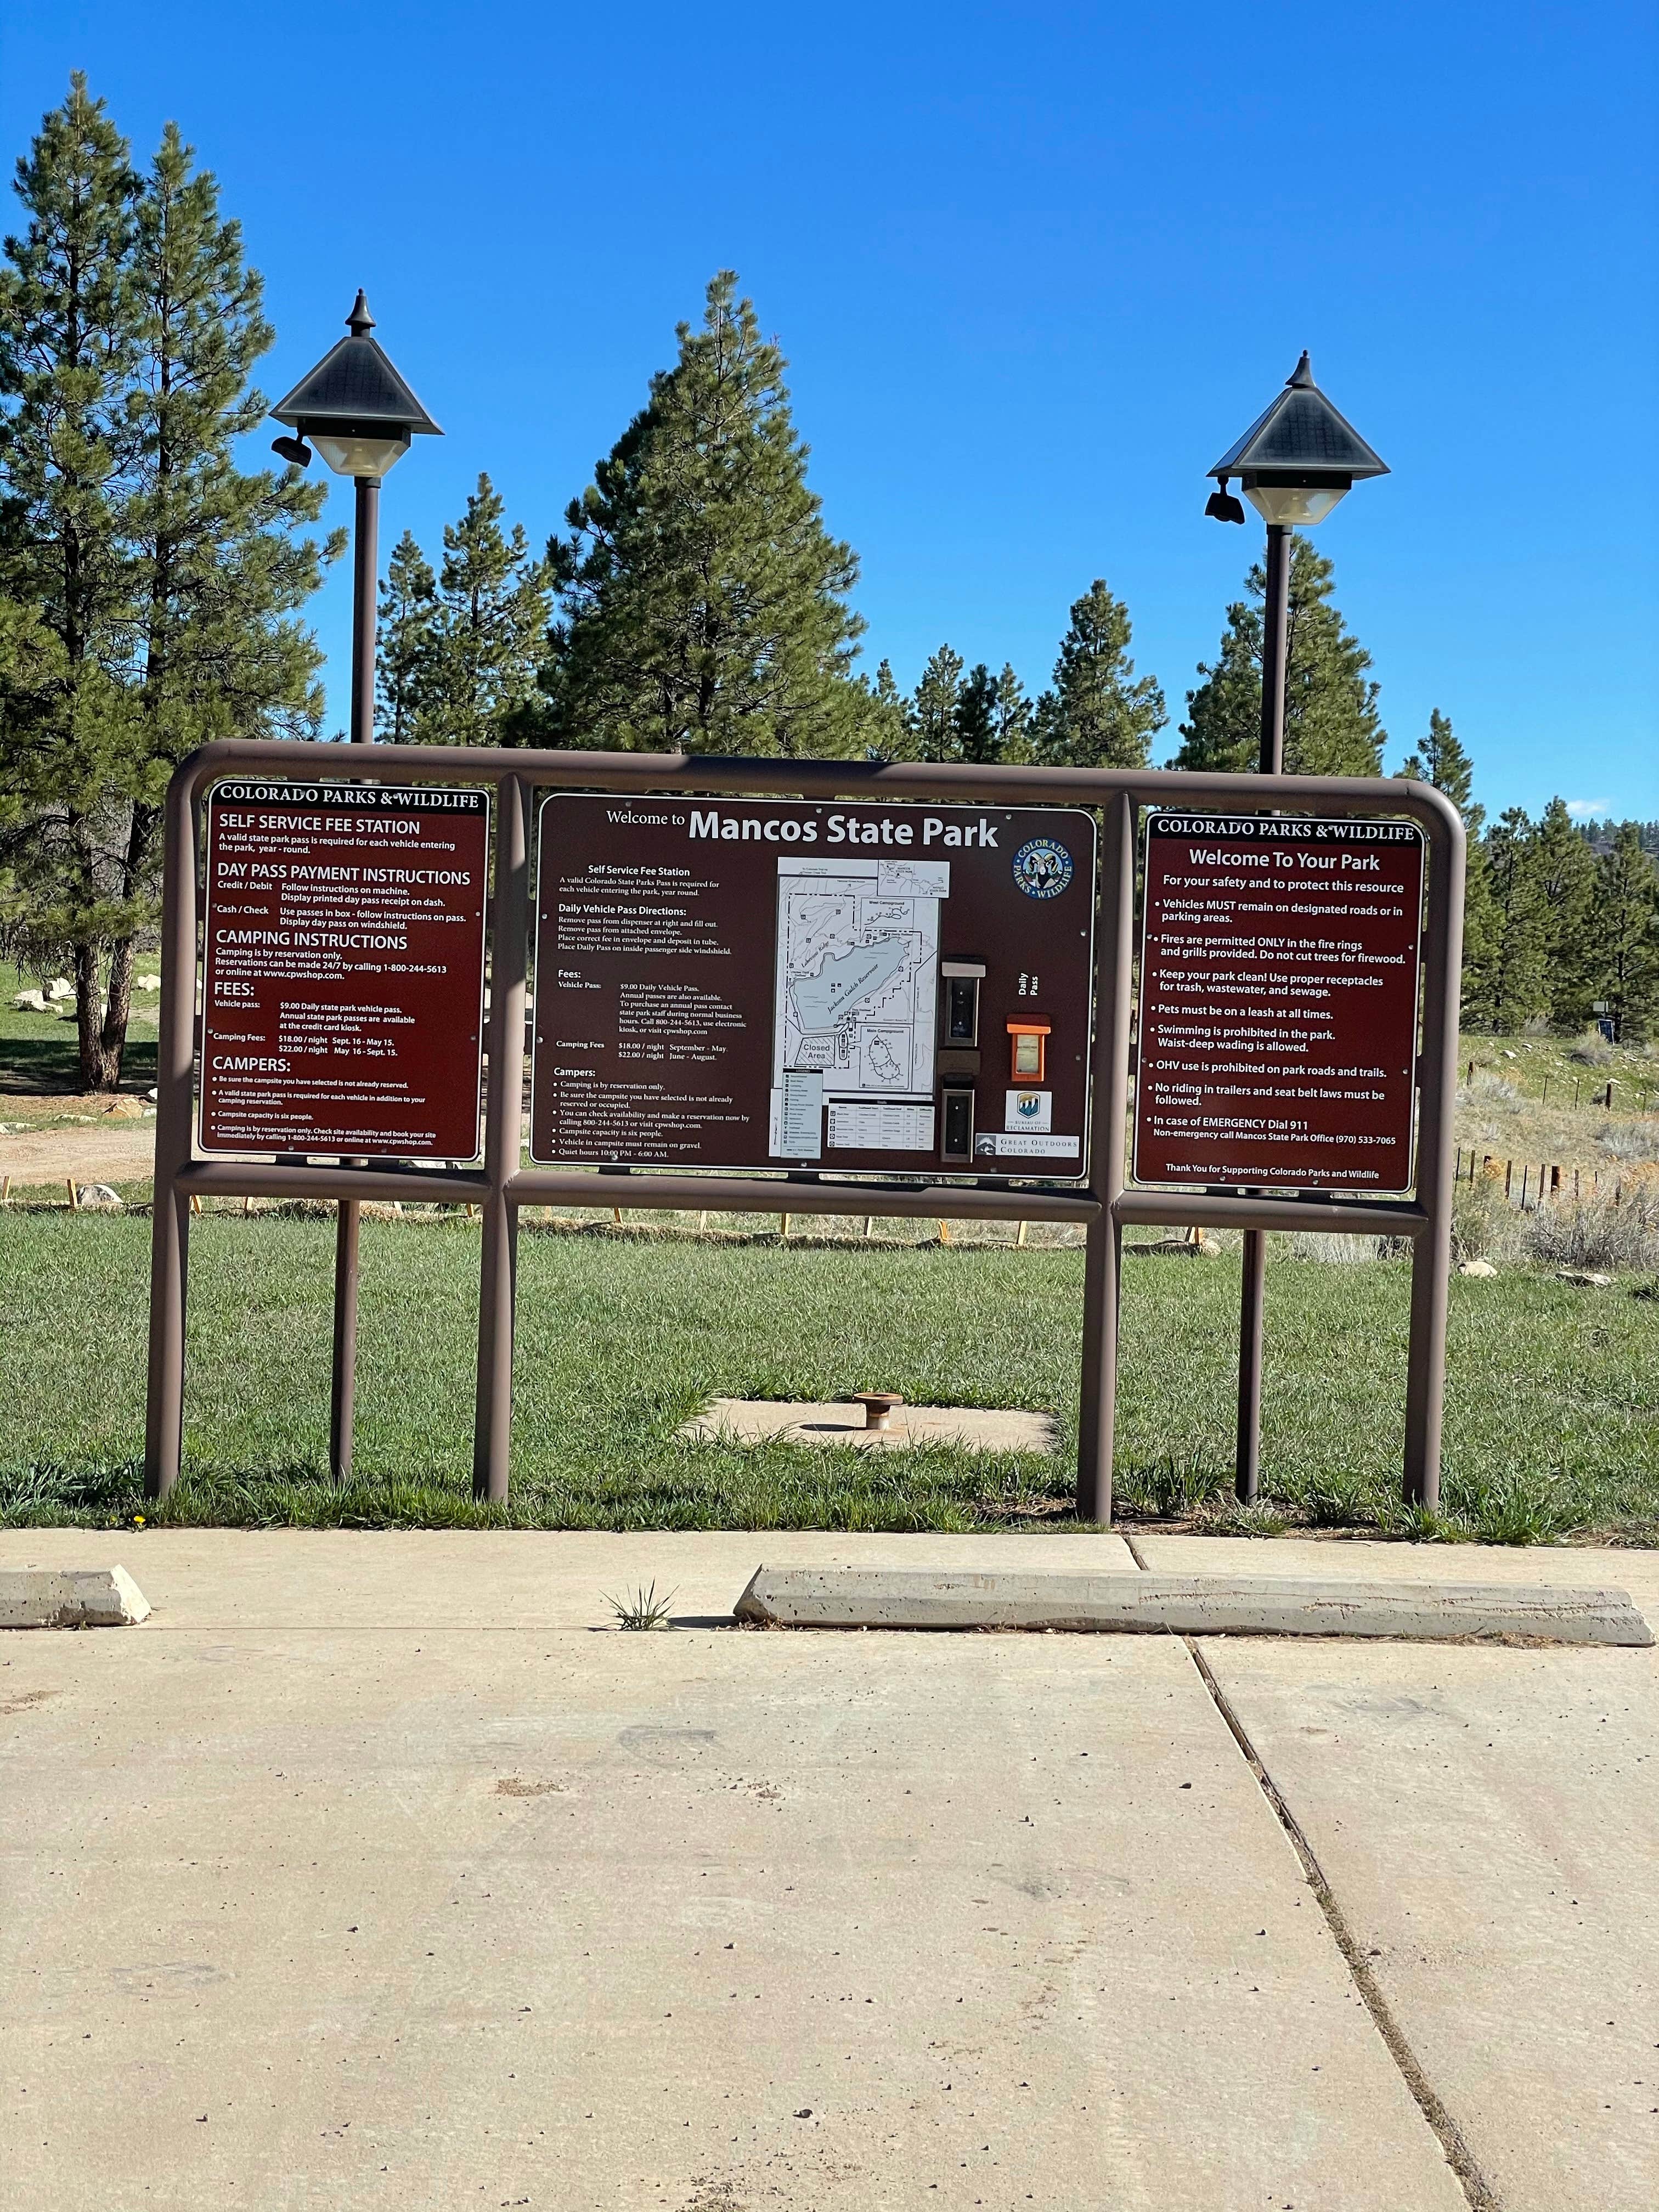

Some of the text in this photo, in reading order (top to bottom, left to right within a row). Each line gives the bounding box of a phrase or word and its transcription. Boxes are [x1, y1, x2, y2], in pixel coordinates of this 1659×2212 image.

[220, 786, 478, 808] COLORADO PARKS & WILDLIFE
[219, 813, 420, 834] SELF SERVICE FEE STATION
[606, 810, 998, 847] Welcome to Mancos State Park
[1158, 819, 1414, 840] COLORADO PARKS & WILDLIFE
[270, 835, 290, 844] park
[319, 837, 354, 846] required
[356, 838, 368, 846] for
[390, 839, 419, 848] vehicle
[420, 841, 455, 851] entering
[1018, 839, 1068, 859] COLORADO
[1189, 849, 1380, 870] Welcome To Your Park
[218, 862, 470, 885] DAY PASS PAYMENT INSTRUCTIONS
[588, 865, 690, 876] Self Service Fee Station
[281, 883, 309, 891] Follow
[310, 884, 359, 893] instructions
[373, 887, 410, 895] machine.
[1014, 865, 1071, 898] PARKS WILDLIFE
[1163, 874, 1404, 893] For your safety and to protect this resource
[558, 904, 686, 916] Daily Vehicle Pass Directions:
[216, 929, 407, 950] CAMPING INSTRUCTIONS
[650, 928, 682, 936] envelope.
[558, 969, 580, 978] Fees:
[215, 981, 254, 996] FEES:
[639, 984, 656, 992] Daily
[827, 964, 878, 1014] Jackson Gulch Reservoir
[1018, 973, 1029, 995] Daily
[301, 1002, 320, 1012] Daily
[340, 1004, 356, 1012] park
[663, 1028, 707, 1036] cpwshop.com
[1158, 1037, 1308, 1052] Waist-deep wading is allowed.
[212, 1056, 290, 1072] CAMPERS:
[554, 1067, 595, 1077] Campers:
[1155, 1094, 1201, 1105] followed.
[1154, 1115, 1163, 1125] In
[1190, 1116, 1201, 1126] of
[1203, 1117, 1266, 1128] EMERGENCY
[1268, 1119, 1288, 1129] Dial
[1290, 1120, 1307, 1130] 911
[559, 1127, 591, 1136] Campsite
[1153, 1128, 1218, 1139] Non-emergency
[1235, 1131, 1266, 1140] Mancos
[1268, 1132, 1289, 1141] State
[1310, 1134, 1334, 1142] Office
[1336, 1135, 1356, 1144] (970)
[1358, 1136, 1396, 1144] 533-7065
[1165, 1163, 1191, 1171] Thank
[1192, 1164, 1207, 1172] You
[1209, 1165, 1221, 1173] for
[1222, 1165, 1268, 1176] Supporting
[1269, 1167, 1306, 1176] Colorado
[1308, 1169, 1330, 1177] Parks
[1348, 1170, 1379, 1178] Wildlife
